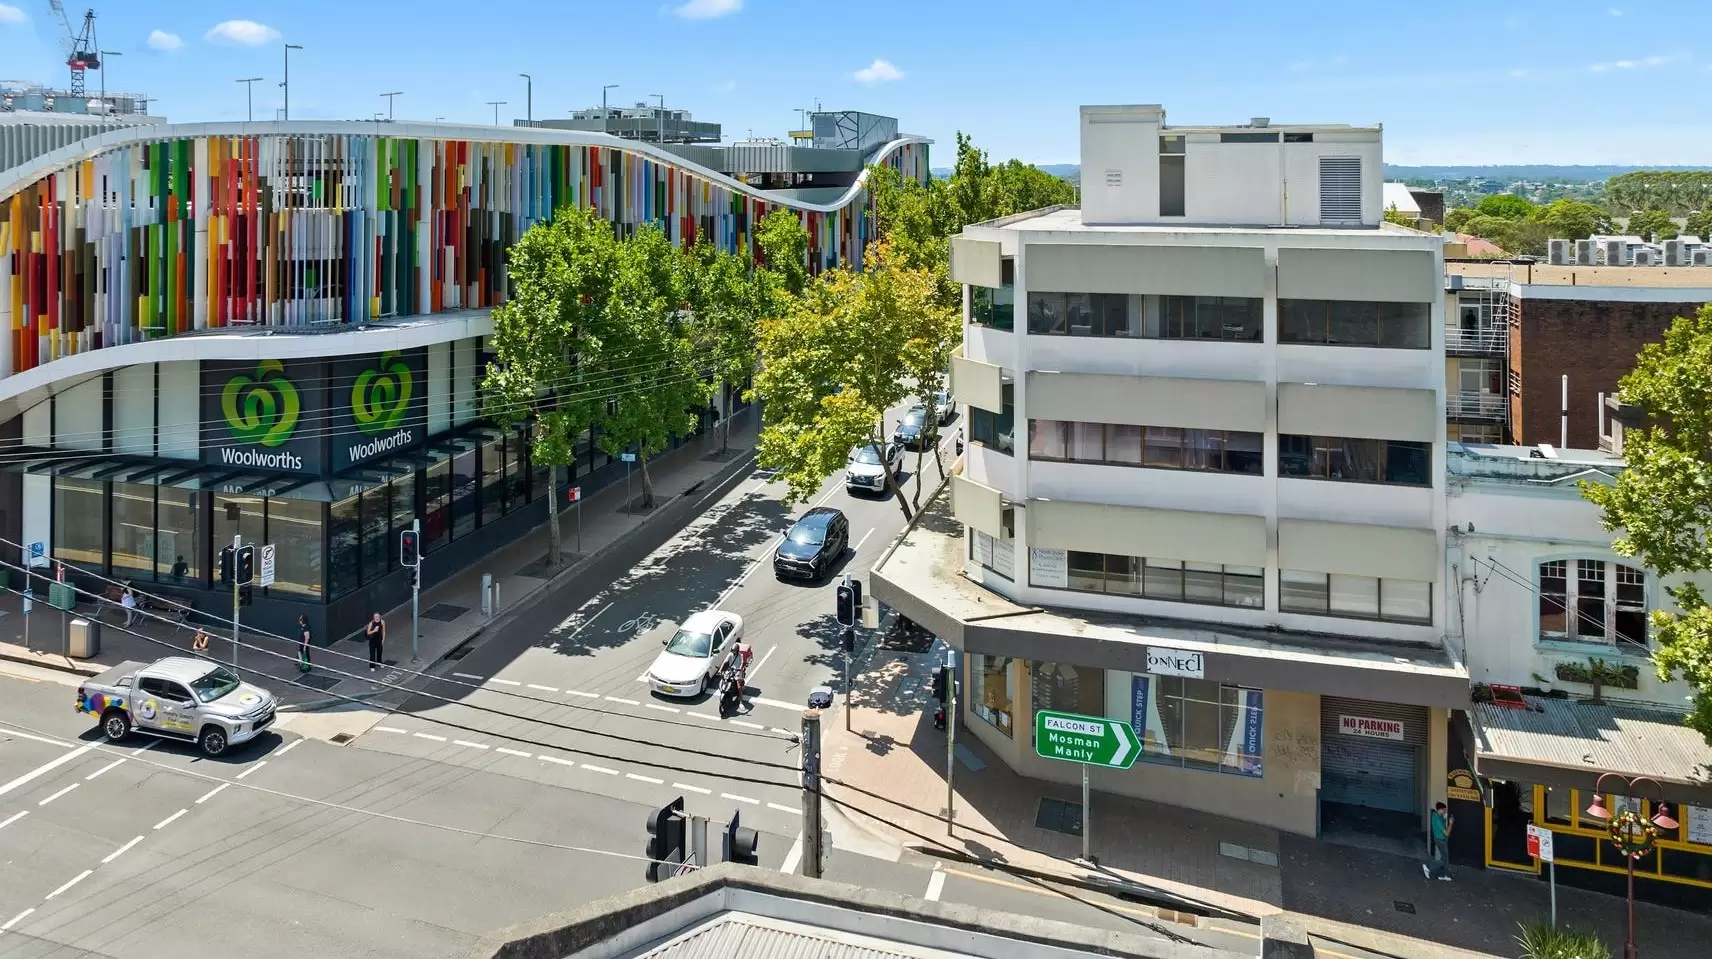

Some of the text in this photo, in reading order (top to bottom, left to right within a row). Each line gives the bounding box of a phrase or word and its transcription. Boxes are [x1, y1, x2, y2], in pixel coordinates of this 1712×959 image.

[349, 429, 411, 462] Woolworths
[221, 447, 302, 470] Woolworths
[1135, 690, 1144, 708] STEP
[1047, 719, 1101, 733] FALCON ST
[1134, 709, 1142, 735] QUICK
[1343, 717, 1401, 734] NO PARKING
[1049, 732, 1100, 749] Mosman
[1364, 730, 1390, 738] HOURS
[1055, 745, 1093, 762] Manly
